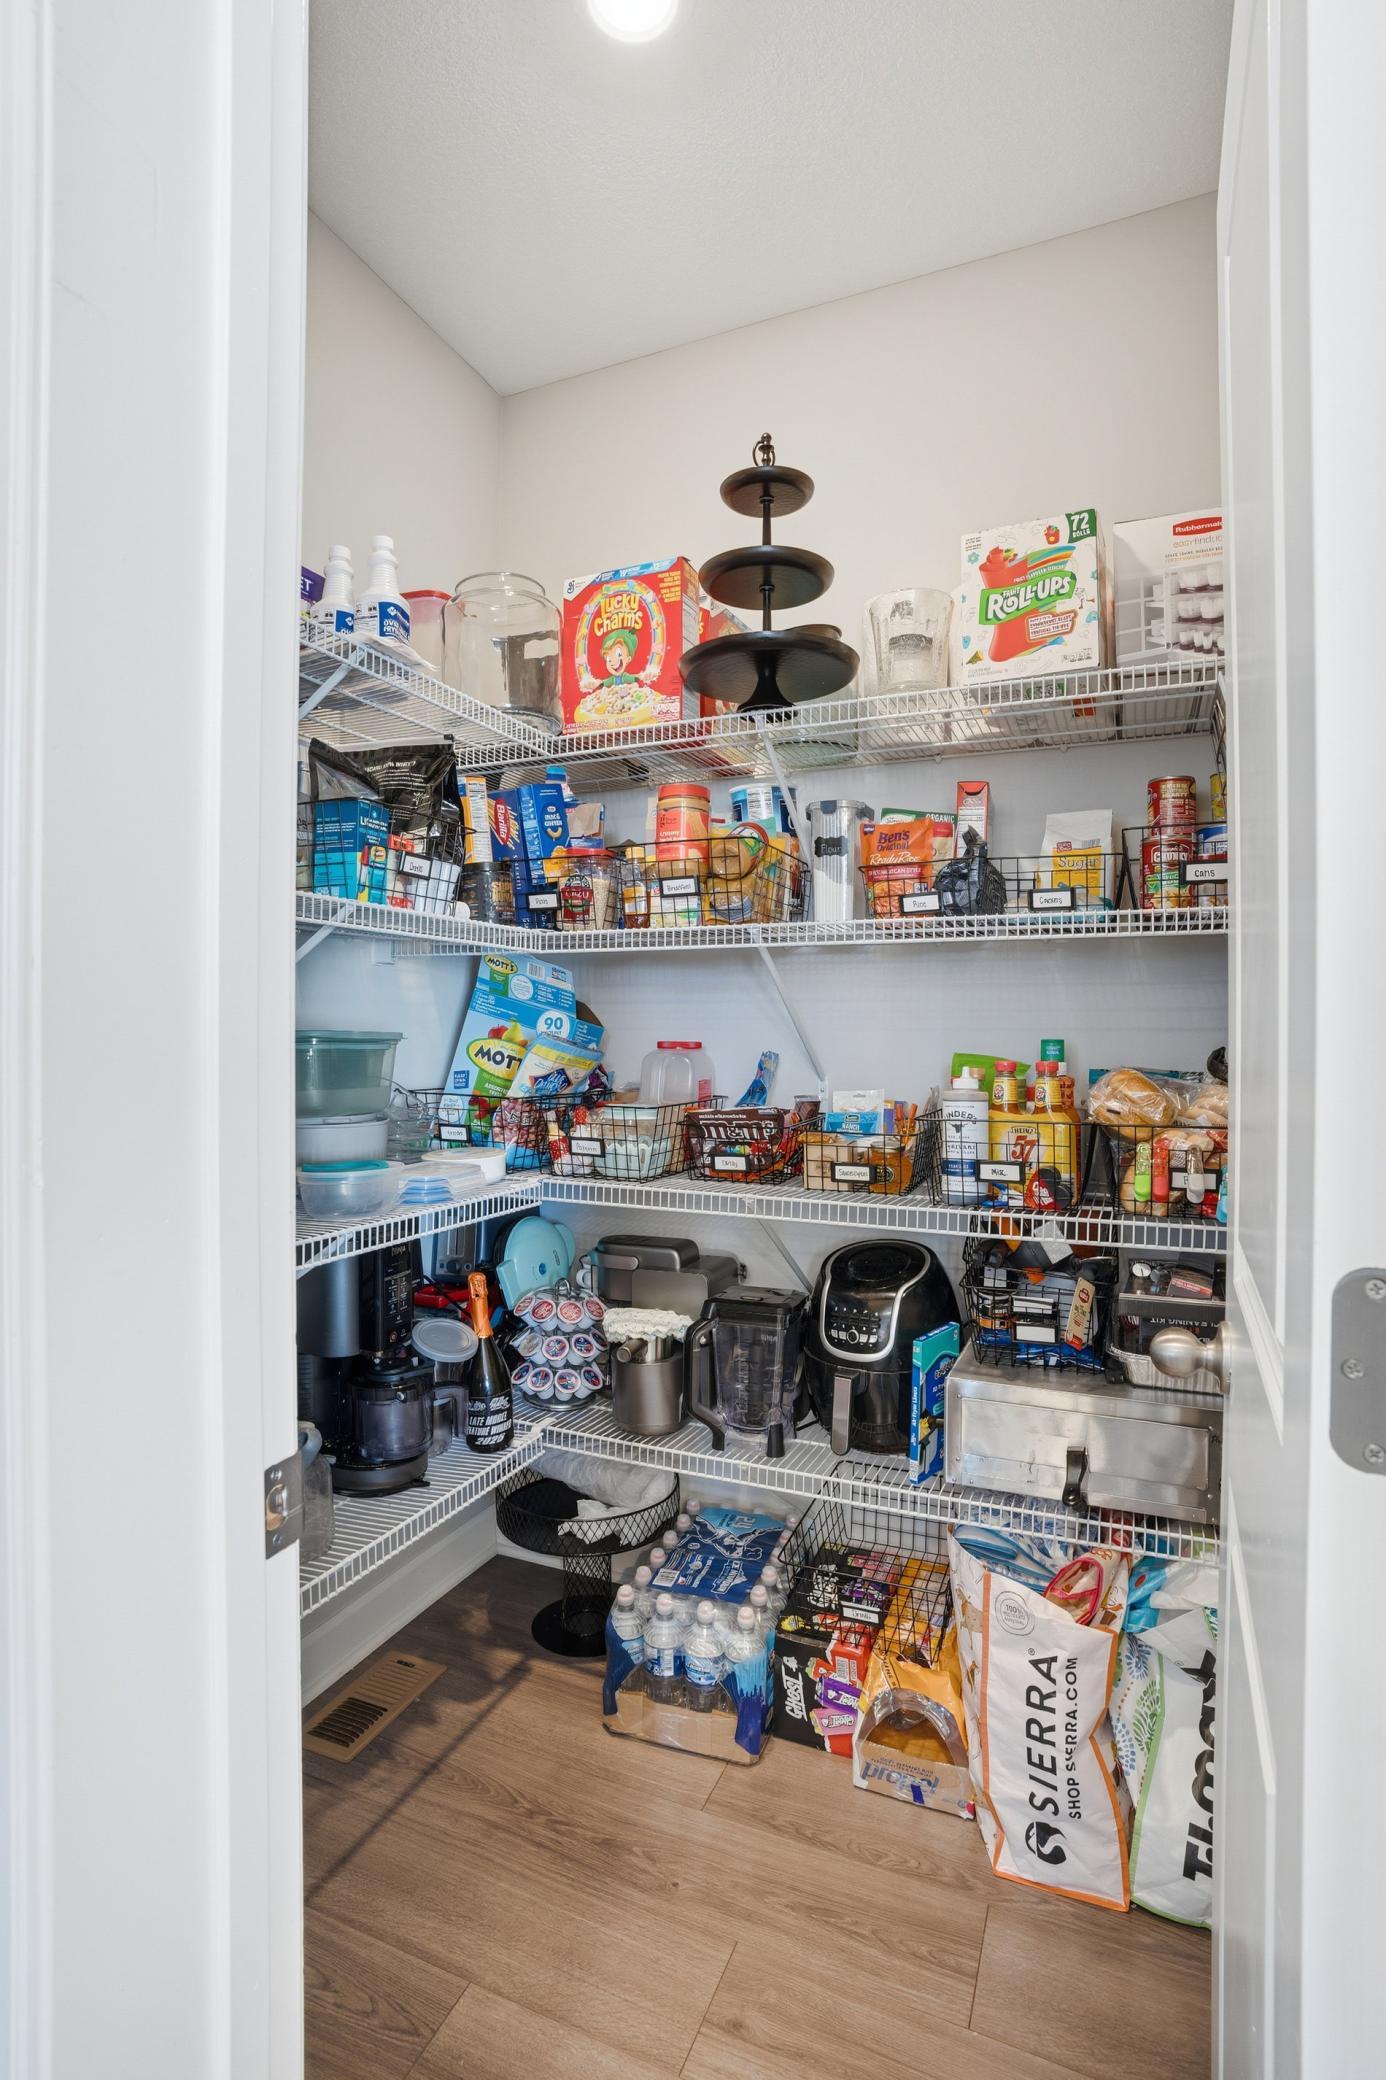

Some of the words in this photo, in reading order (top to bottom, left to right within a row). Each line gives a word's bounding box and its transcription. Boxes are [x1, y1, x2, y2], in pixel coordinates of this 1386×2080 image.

[1070, 512, 1089, 531] 72
[602, 591, 641, 617] Lucky
[986, 574, 1072, 621] ROLL-UPS
[594, 610, 643, 637] Charms
[496, 804, 507, 840] Barilla
[926, 813, 954, 823] ORGANIC
[877, 841, 910, 852] Original
[878, 830, 910, 844] Ben's
[821, 844, 842, 854] Flour
[870, 854, 896, 866] Ready
[895, 851, 920, 863] Rice
[1058, 856, 1100, 869] Sugar
[1194, 869, 1215, 878] Cans
[544, 1017, 563, 1030] 90
[1011, 1135, 1038, 1164] 57
[783, 1663, 808, 1721] GHOST
[833, 1690, 858, 1709] HOST
[1065, 1657, 1079, 1772] SERRA.COM
[1026, 1655, 1059, 1817] SIERRA
[1067, 1777, 1081, 1819] SHOP
